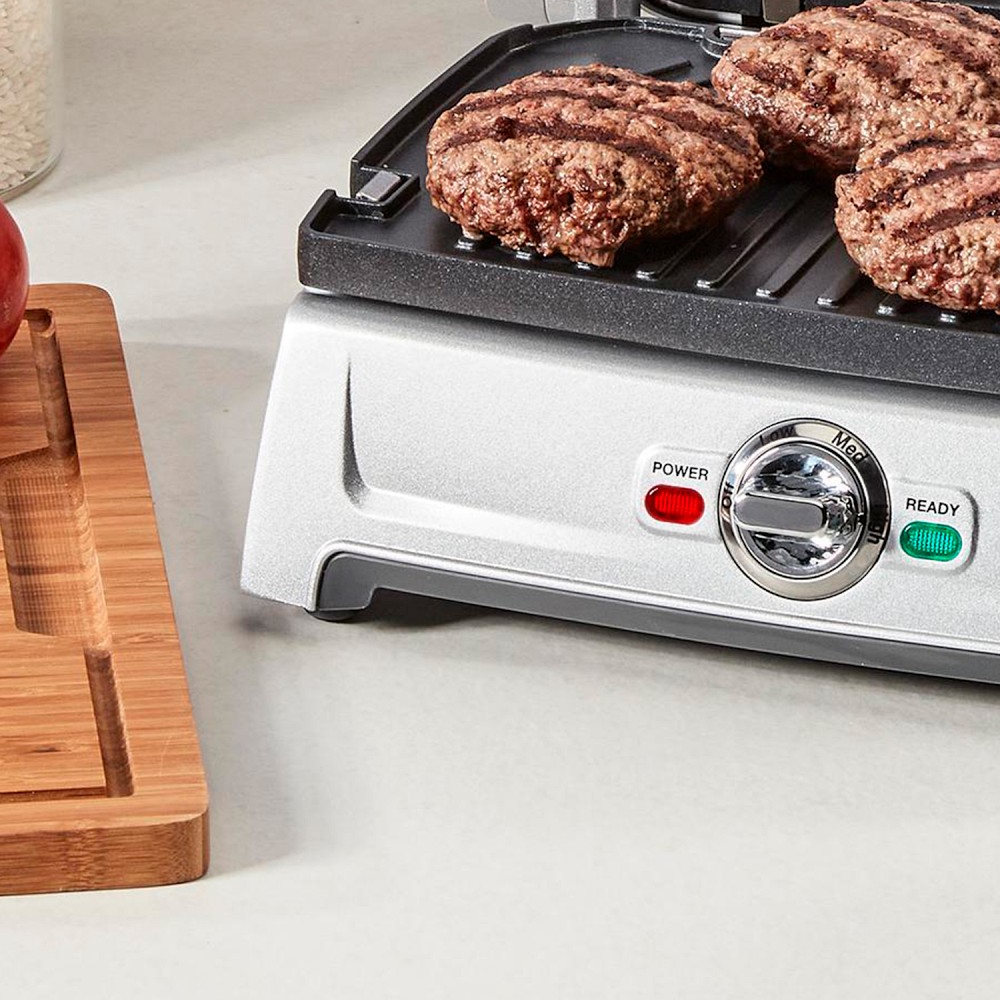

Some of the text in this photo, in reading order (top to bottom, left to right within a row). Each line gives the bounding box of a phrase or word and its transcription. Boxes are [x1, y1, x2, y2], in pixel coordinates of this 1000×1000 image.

[759, 425, 796, 446] Low
[831, 431, 868, 463] Med
[652, 461, 709, 481] POWER
[722, 481, 734, 507] Off
[906, 498, 960, 517] READY
